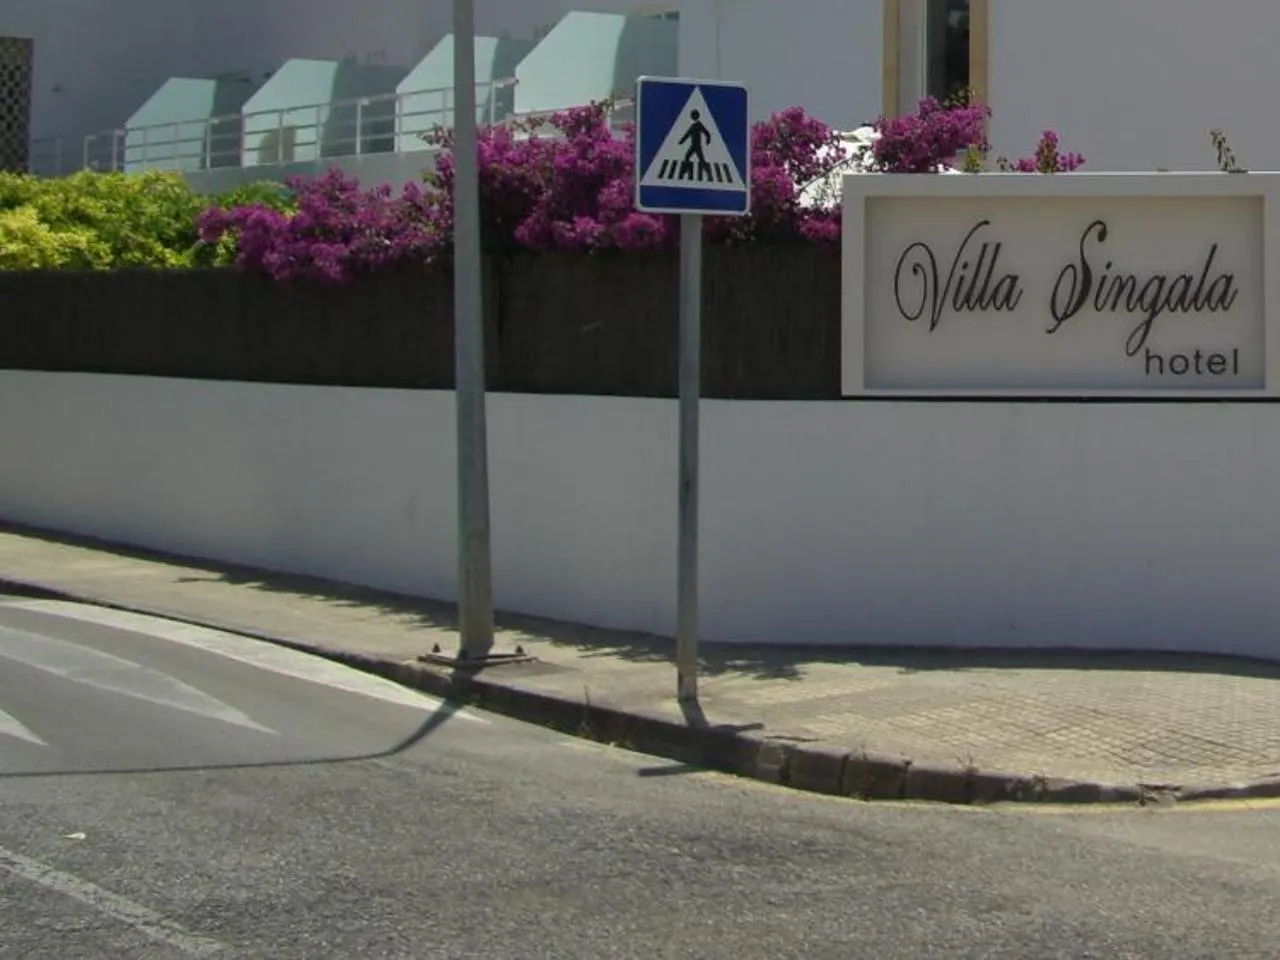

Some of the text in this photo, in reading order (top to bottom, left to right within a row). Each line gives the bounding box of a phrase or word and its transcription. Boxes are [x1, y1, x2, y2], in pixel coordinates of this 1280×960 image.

[894, 219, 1239, 357] Villa Singala
[1145, 347, 1239, 376] hotel
